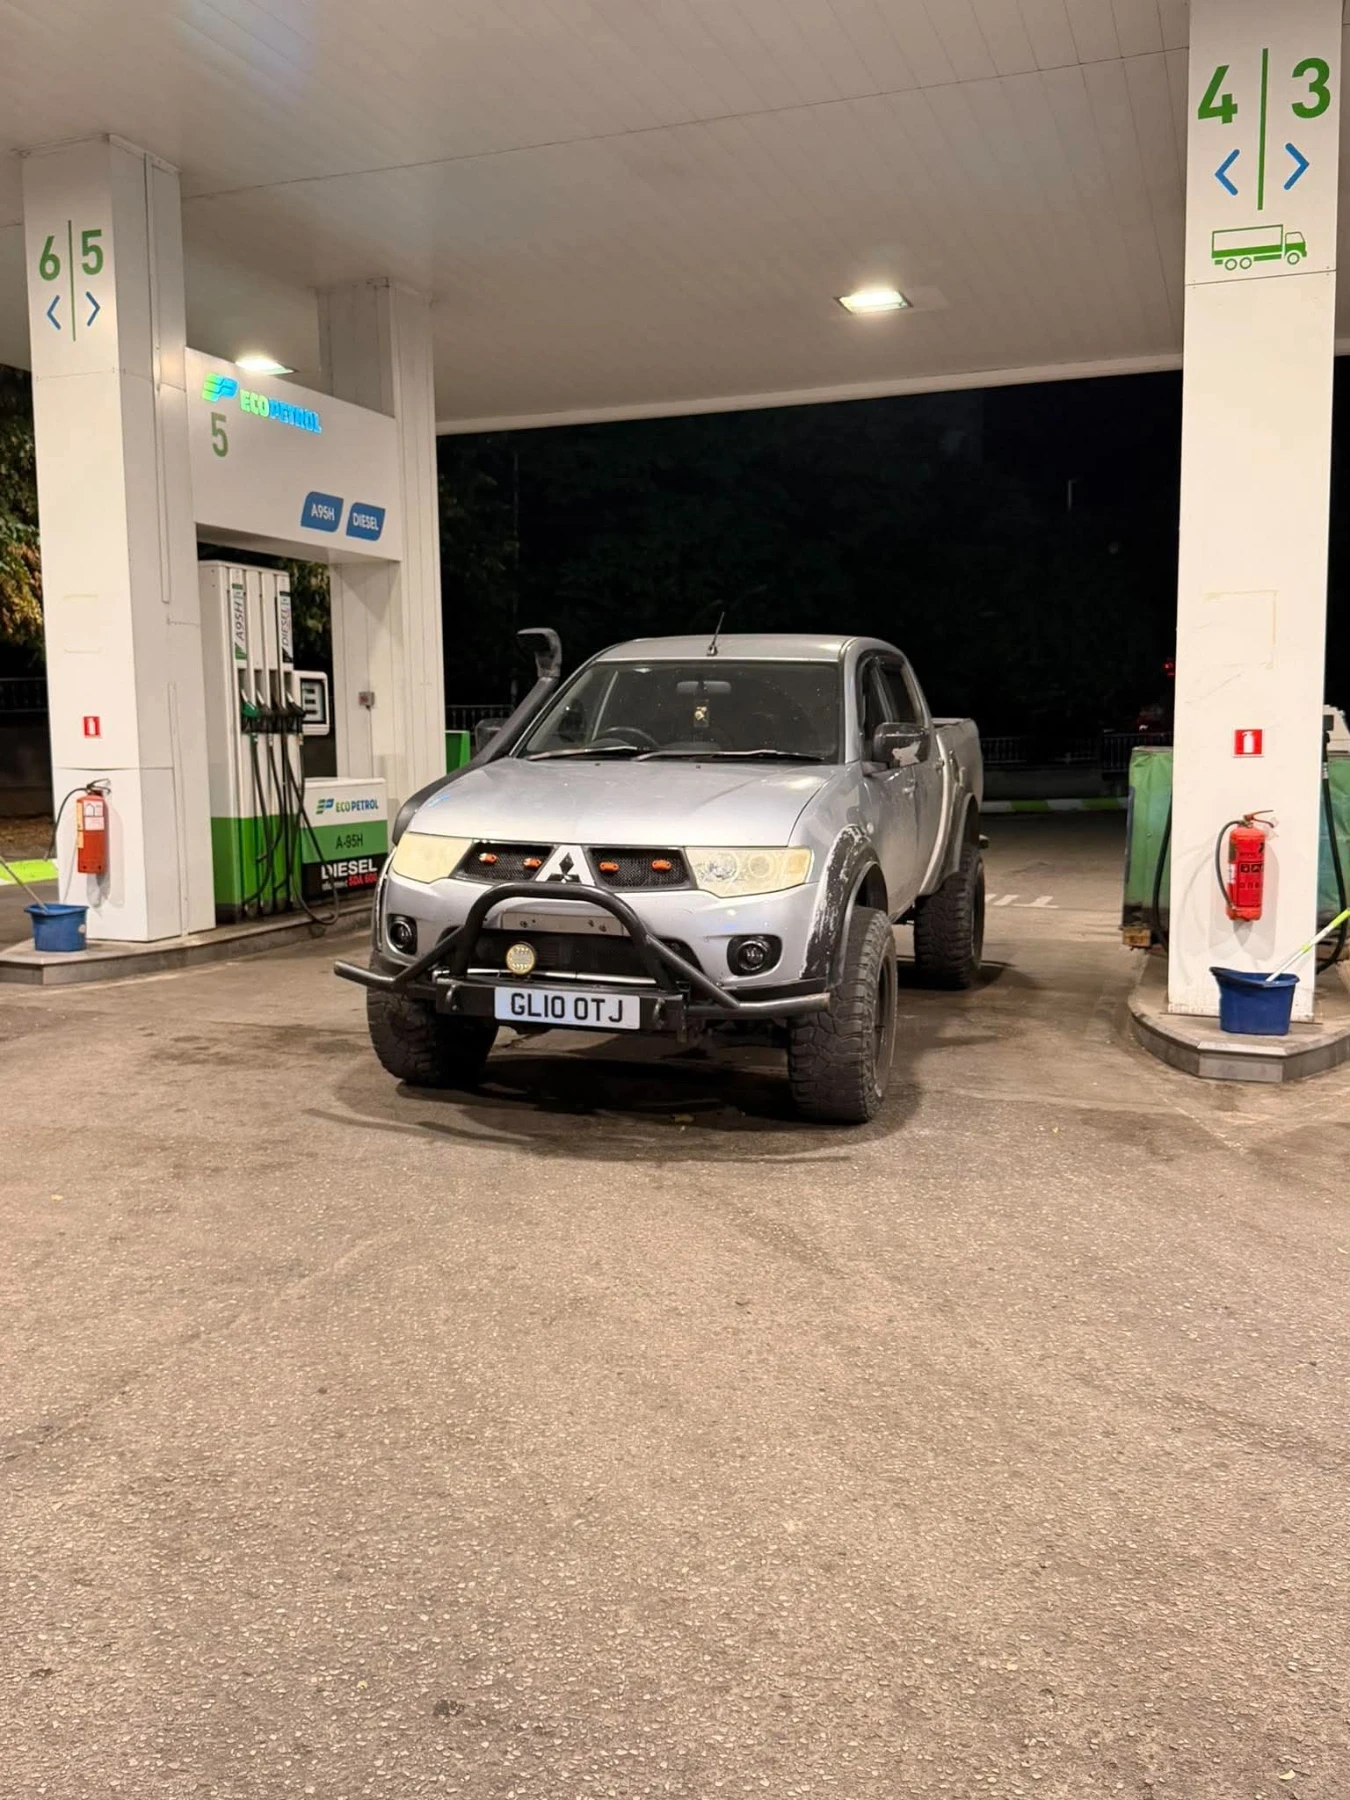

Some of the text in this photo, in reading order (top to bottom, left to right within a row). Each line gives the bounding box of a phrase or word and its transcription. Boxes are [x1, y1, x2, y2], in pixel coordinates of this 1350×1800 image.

[1198, 57, 1331, 124] 4 3
[39, 229, 104, 281] 6 5
[210, 412, 229, 457] 5
[311, 503, 335, 521] A95H
[352, 512, 379, 531] DIESEL
[234, 600, 246, 642] A95H
[281, 607, 290, 647] DIESEL
[336, 800, 378, 812] ECOPETROL
[336, 833, 364, 850] A-95H
[321, 859, 378, 879] DIESEL
[511, 993, 623, 1023] GL10 OTJ
